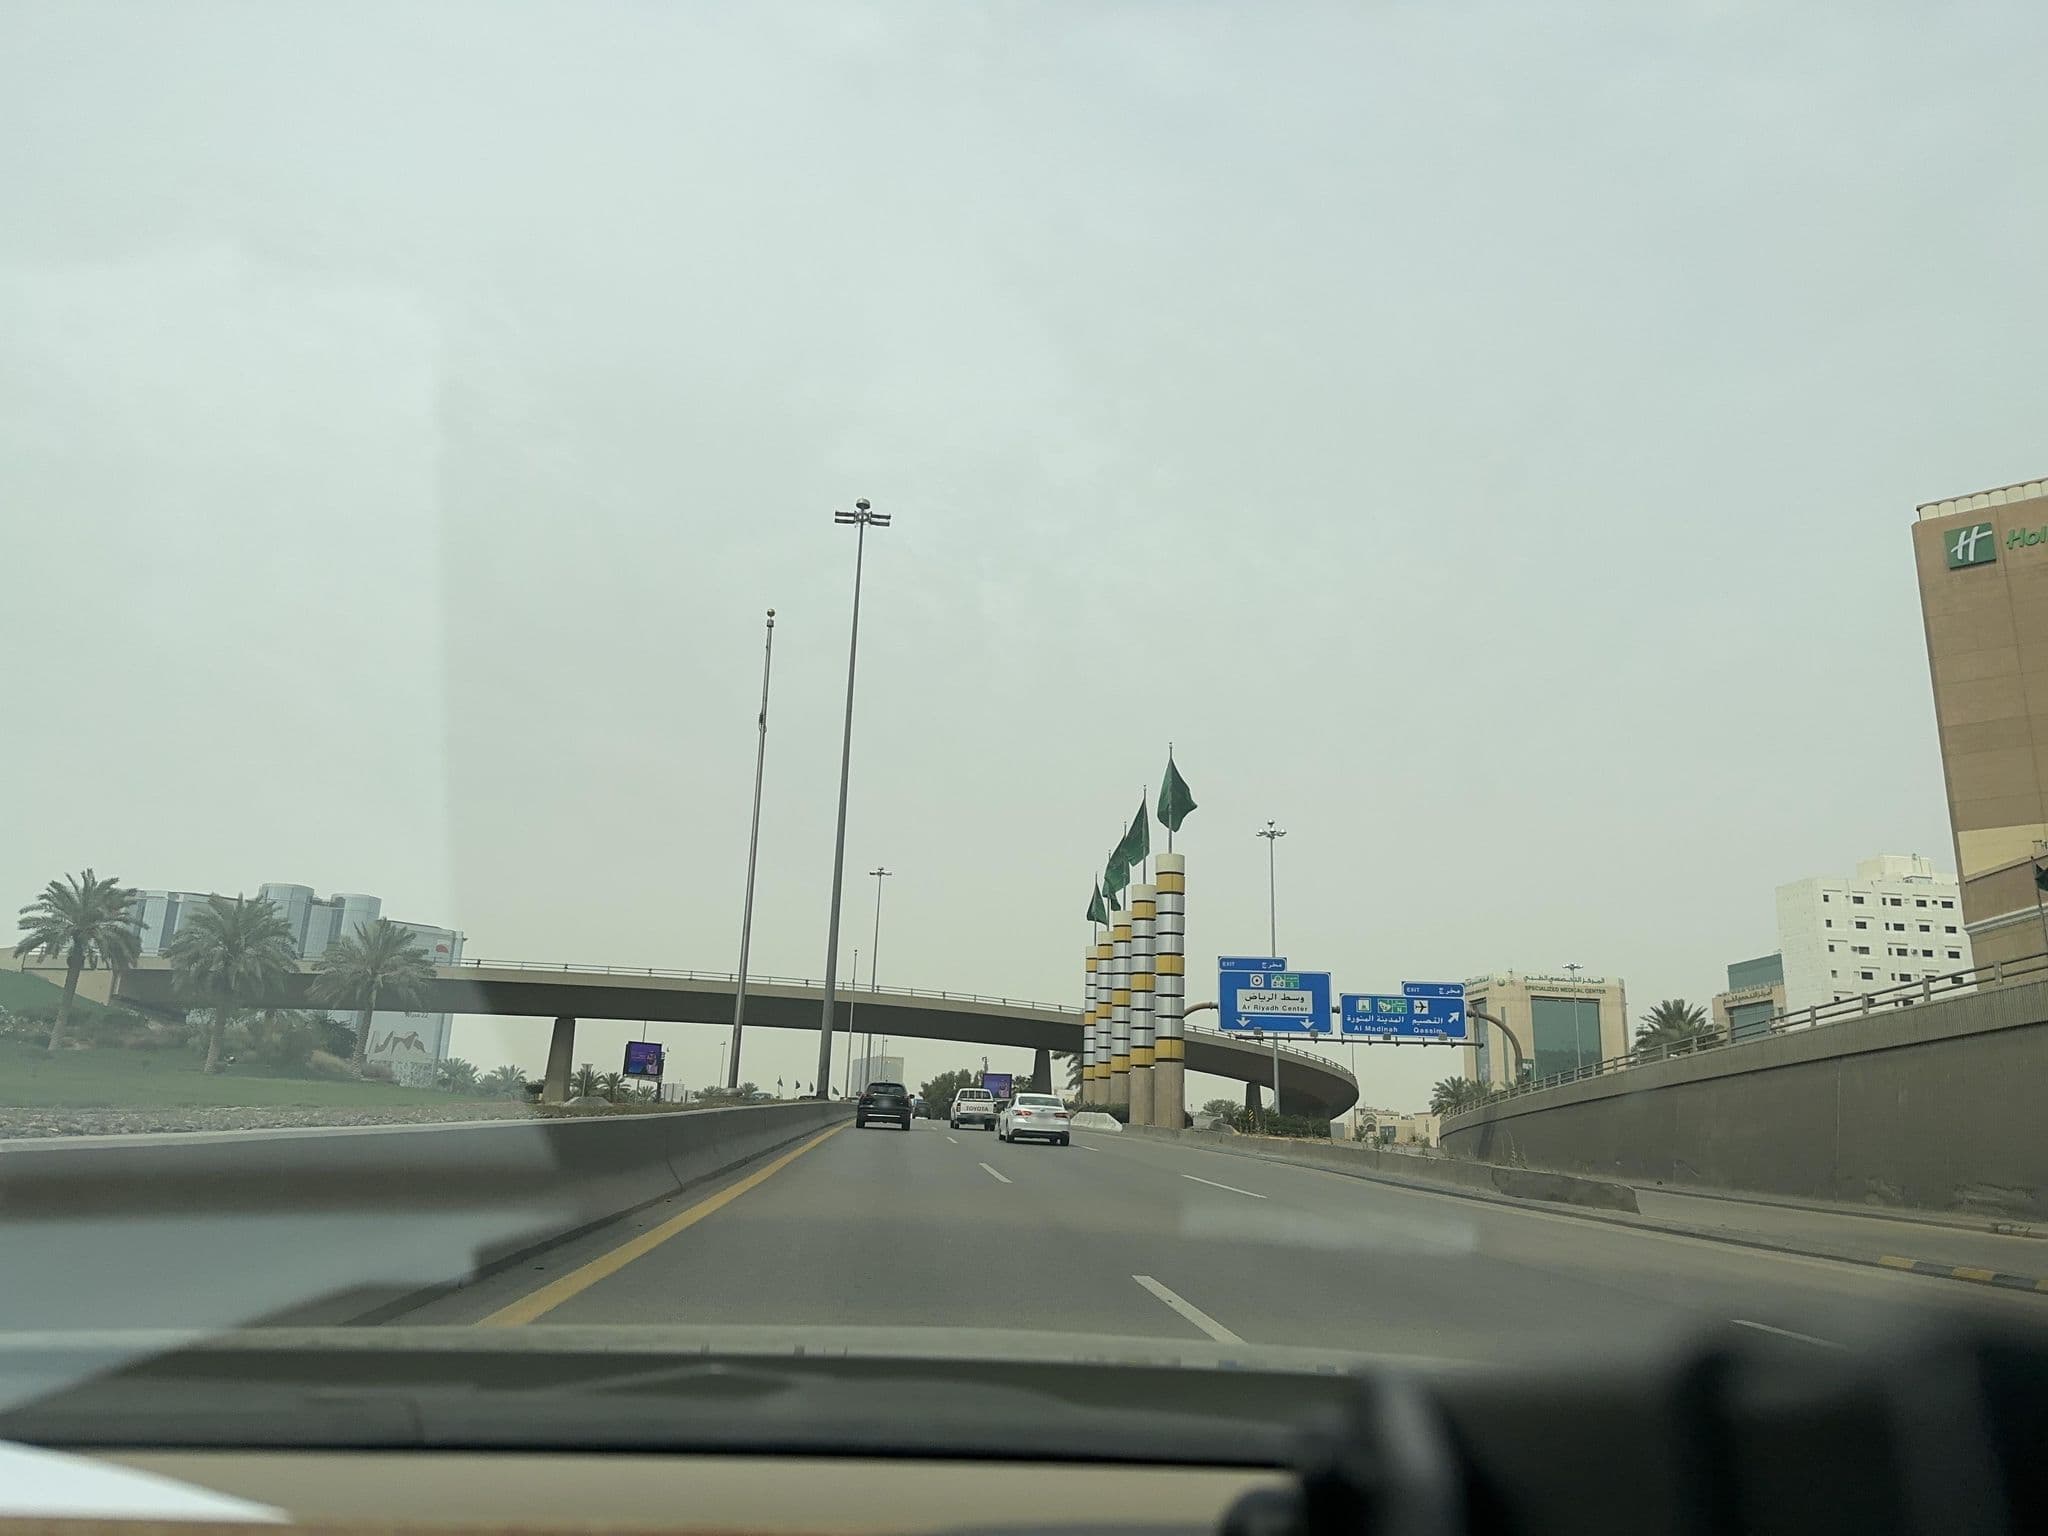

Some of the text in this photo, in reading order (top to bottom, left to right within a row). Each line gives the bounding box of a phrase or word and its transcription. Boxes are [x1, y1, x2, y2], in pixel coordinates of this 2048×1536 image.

[1262, 961, 1282, 969] مخرج
[1438, 987, 1460, 995] مخرج
[1245, 993, 1304, 1003] وسط الرياض
[1253, 1003, 1279, 1012] Riyadh
[1376, 1015, 1404, 1025] المدينة
[1412, 1016, 1443, 1026] القصيم
[1364, 1025, 1398, 1033] Madinah
